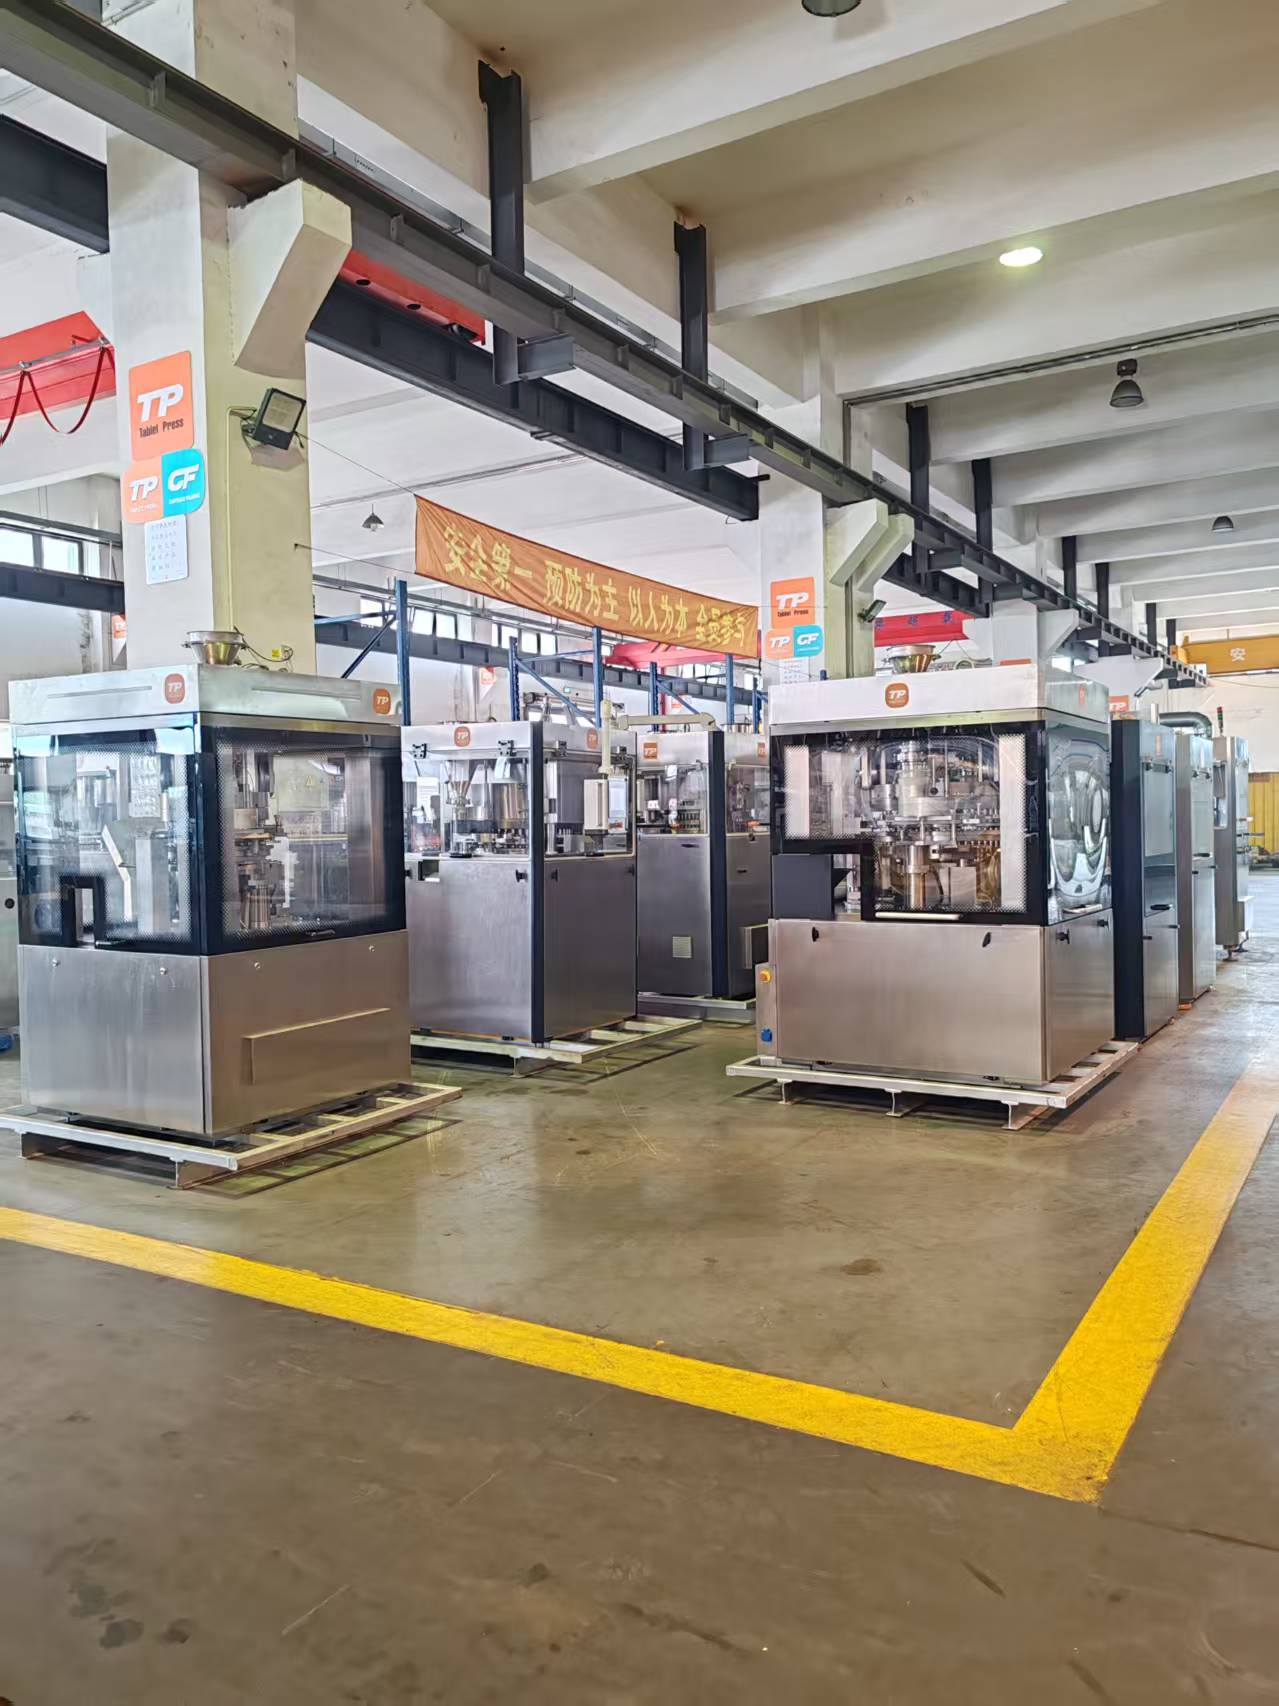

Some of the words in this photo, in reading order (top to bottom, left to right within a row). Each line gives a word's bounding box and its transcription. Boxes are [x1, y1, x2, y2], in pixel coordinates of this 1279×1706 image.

[137, 383, 184, 422] TP
[162, 418, 184, 432] Press
[129, 475, 160, 502] TP
[443, 523, 533, 592] 安全第一
[543, 559, 619, 621] 预防为主
[628, 585, 689, 638] 以人为本
[776, 591, 809, 609] TP
[770, 635, 790, 648] TP
[167, 682, 183, 692] TP
[376, 695, 389, 705] TP
[888, 690, 907, 700] TP
